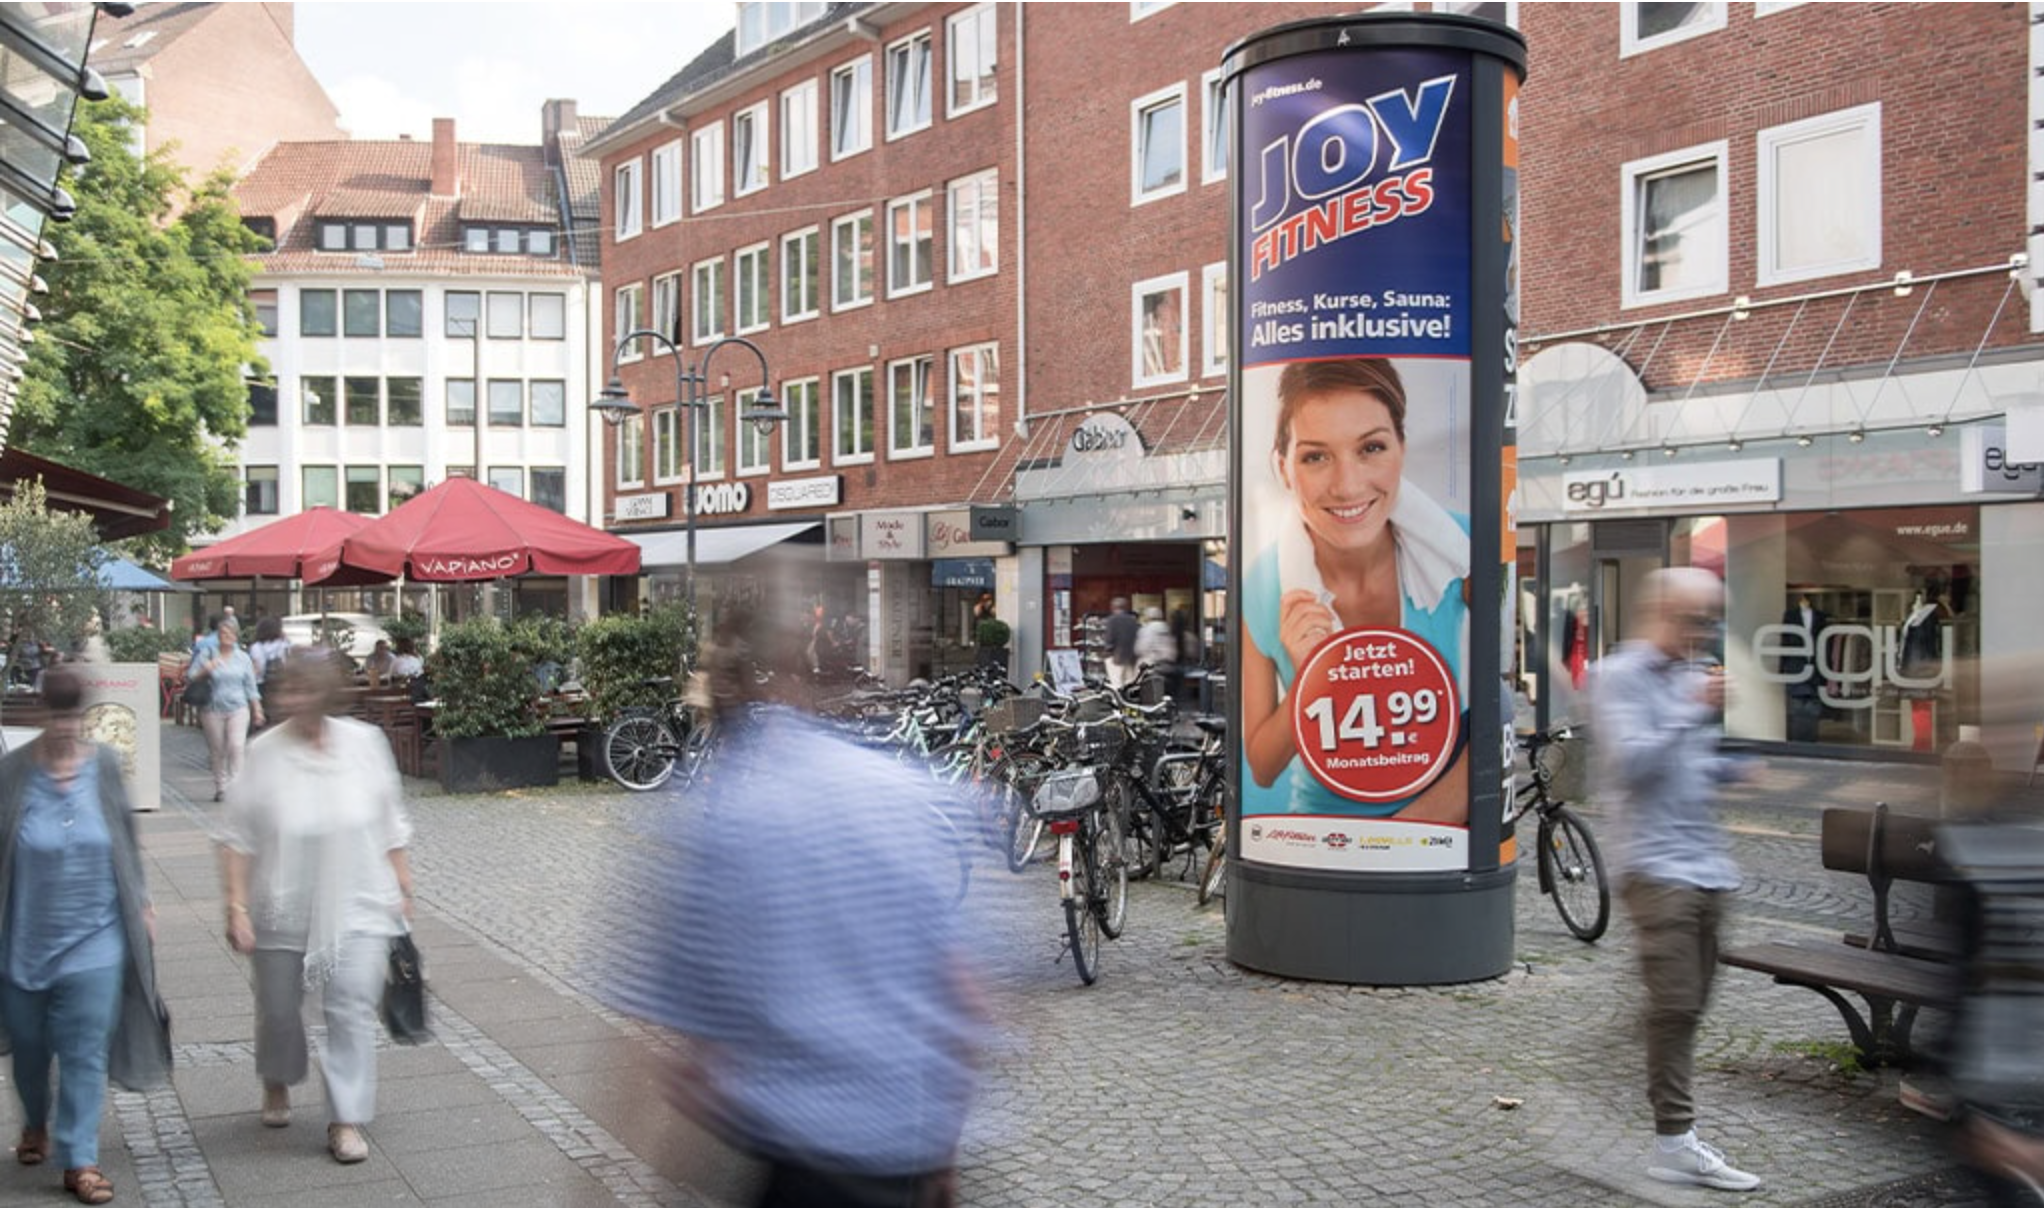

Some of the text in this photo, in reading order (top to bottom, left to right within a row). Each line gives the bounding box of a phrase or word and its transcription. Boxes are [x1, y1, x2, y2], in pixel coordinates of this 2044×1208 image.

[1252, 73, 1458, 233] JOY
[1251, 167, 1434, 283] FITNESS
[1251, 290, 1451, 319] Fitness, Kurse, Sauna:
[1251, 311, 1451, 349] Alles inklusive!
[1567, 471, 1625, 507] egú
[1896, 521, 1969, 537] www.egue.de
[421, 554, 520, 575] VAPIANO
[1343, 641, 1398, 662] Jetzt
[1327, 658, 1416, 682] starten!
[1326, 751, 1431, 769] Monatsbeitrag
